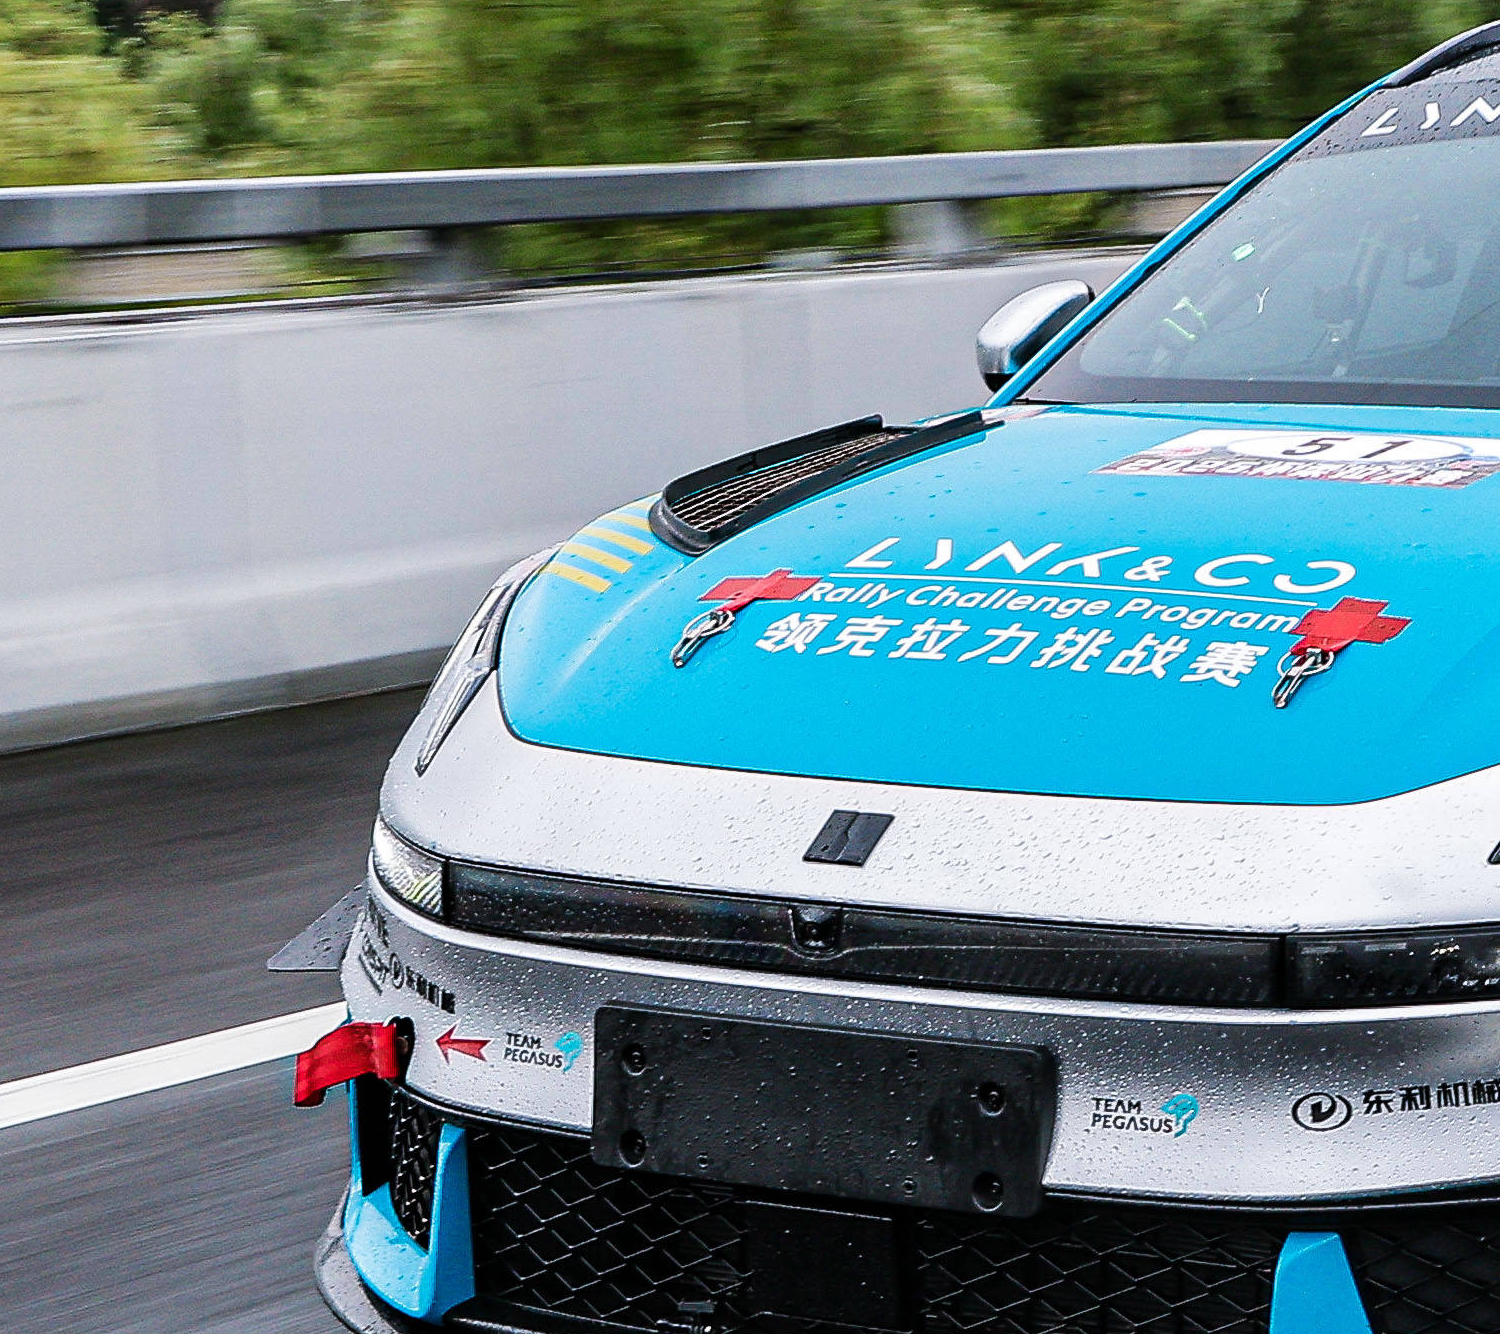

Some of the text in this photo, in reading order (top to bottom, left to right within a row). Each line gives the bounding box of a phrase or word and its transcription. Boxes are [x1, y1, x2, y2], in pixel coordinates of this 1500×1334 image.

[800, 582, 1301, 635] Rally Challenge Program
[755, 611, 1272, 688] 领克拉力挑战赛
[506, 1032, 543, 1049] TEAM
[503, 1047, 564, 1068] PEGASUS
[1090, 1097, 1142, 1115] TEAM
[1090, 1113, 1174, 1134] PEGASUS
